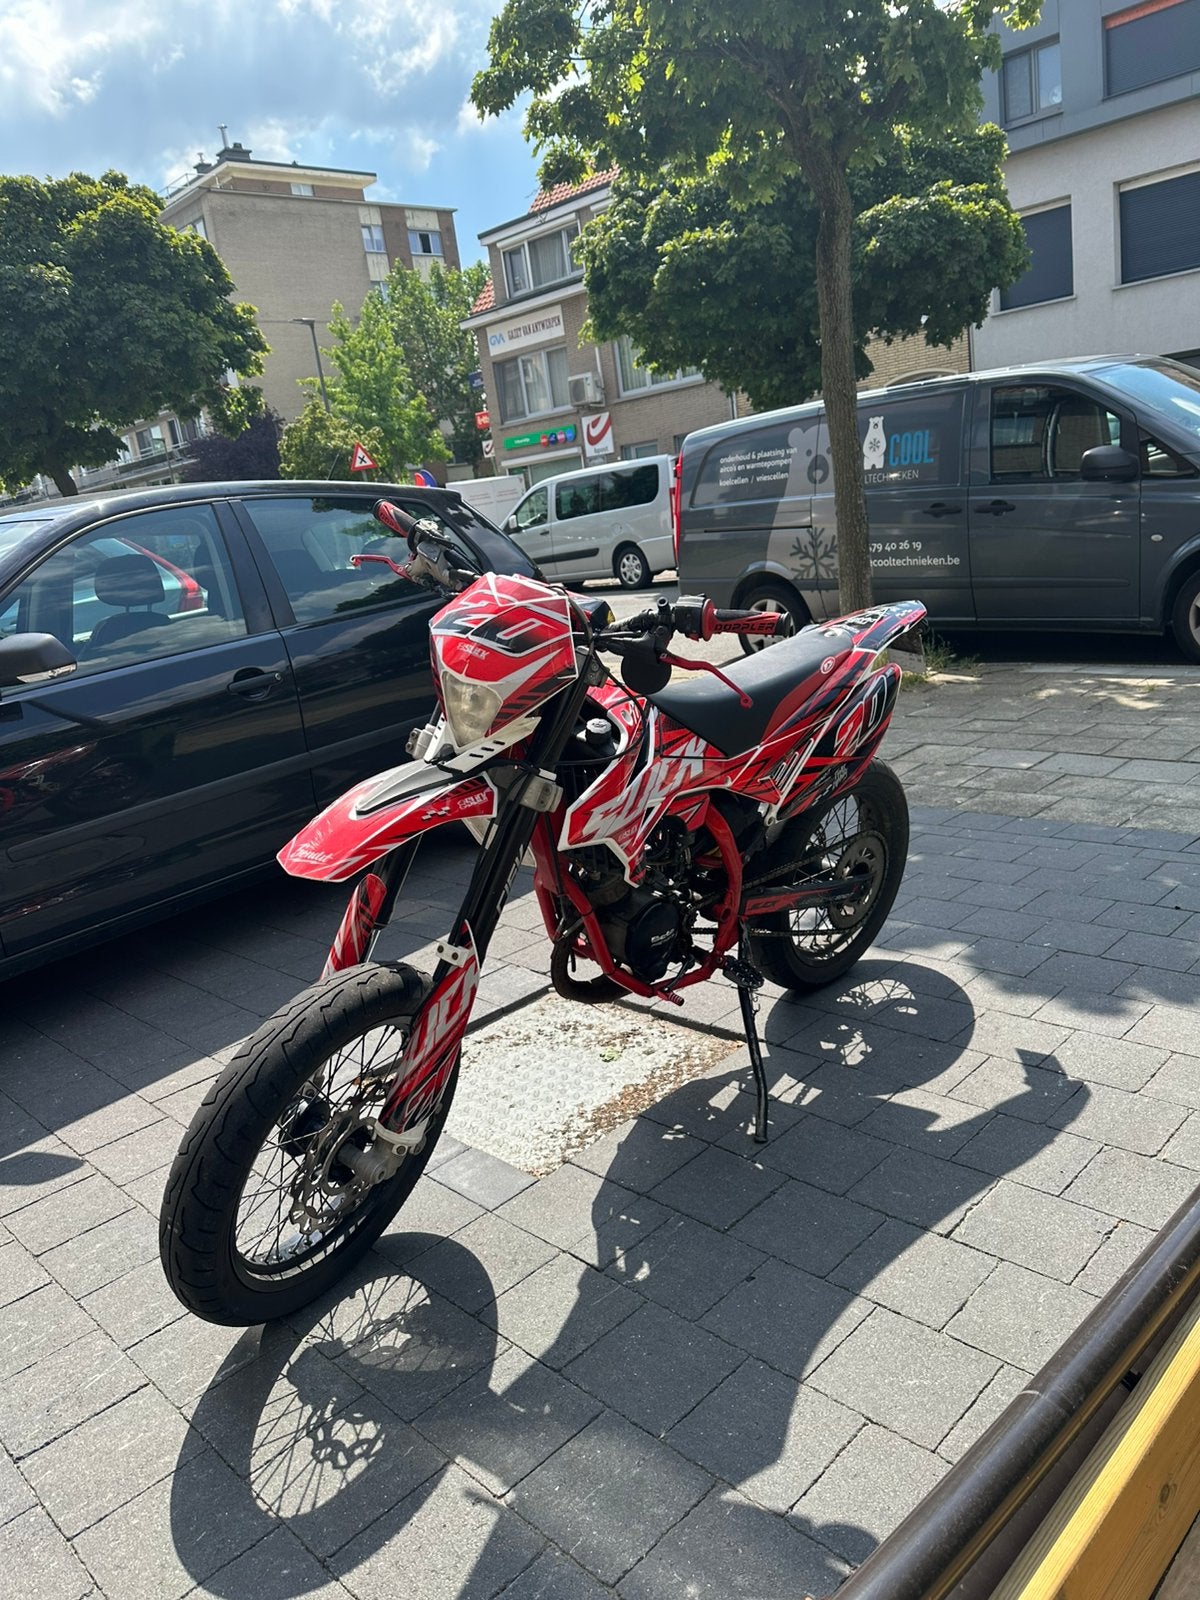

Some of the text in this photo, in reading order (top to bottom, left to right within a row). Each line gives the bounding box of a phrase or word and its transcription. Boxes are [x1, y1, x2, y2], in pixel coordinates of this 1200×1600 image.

[719, 447, 798, 464] onderhoud & plaatsing van
[888, 429, 934, 467] COOL
[746, 458, 793, 470] warmtepompen
[719, 476, 749, 487] koelcellen
[755, 471, 789, 482] vriescellen
[884, 542, 897, 553] 40
[898, 539, 910, 550] 26
[912, 541, 922, 551] 19
[714, 622, 776, 632] DOPPLER
